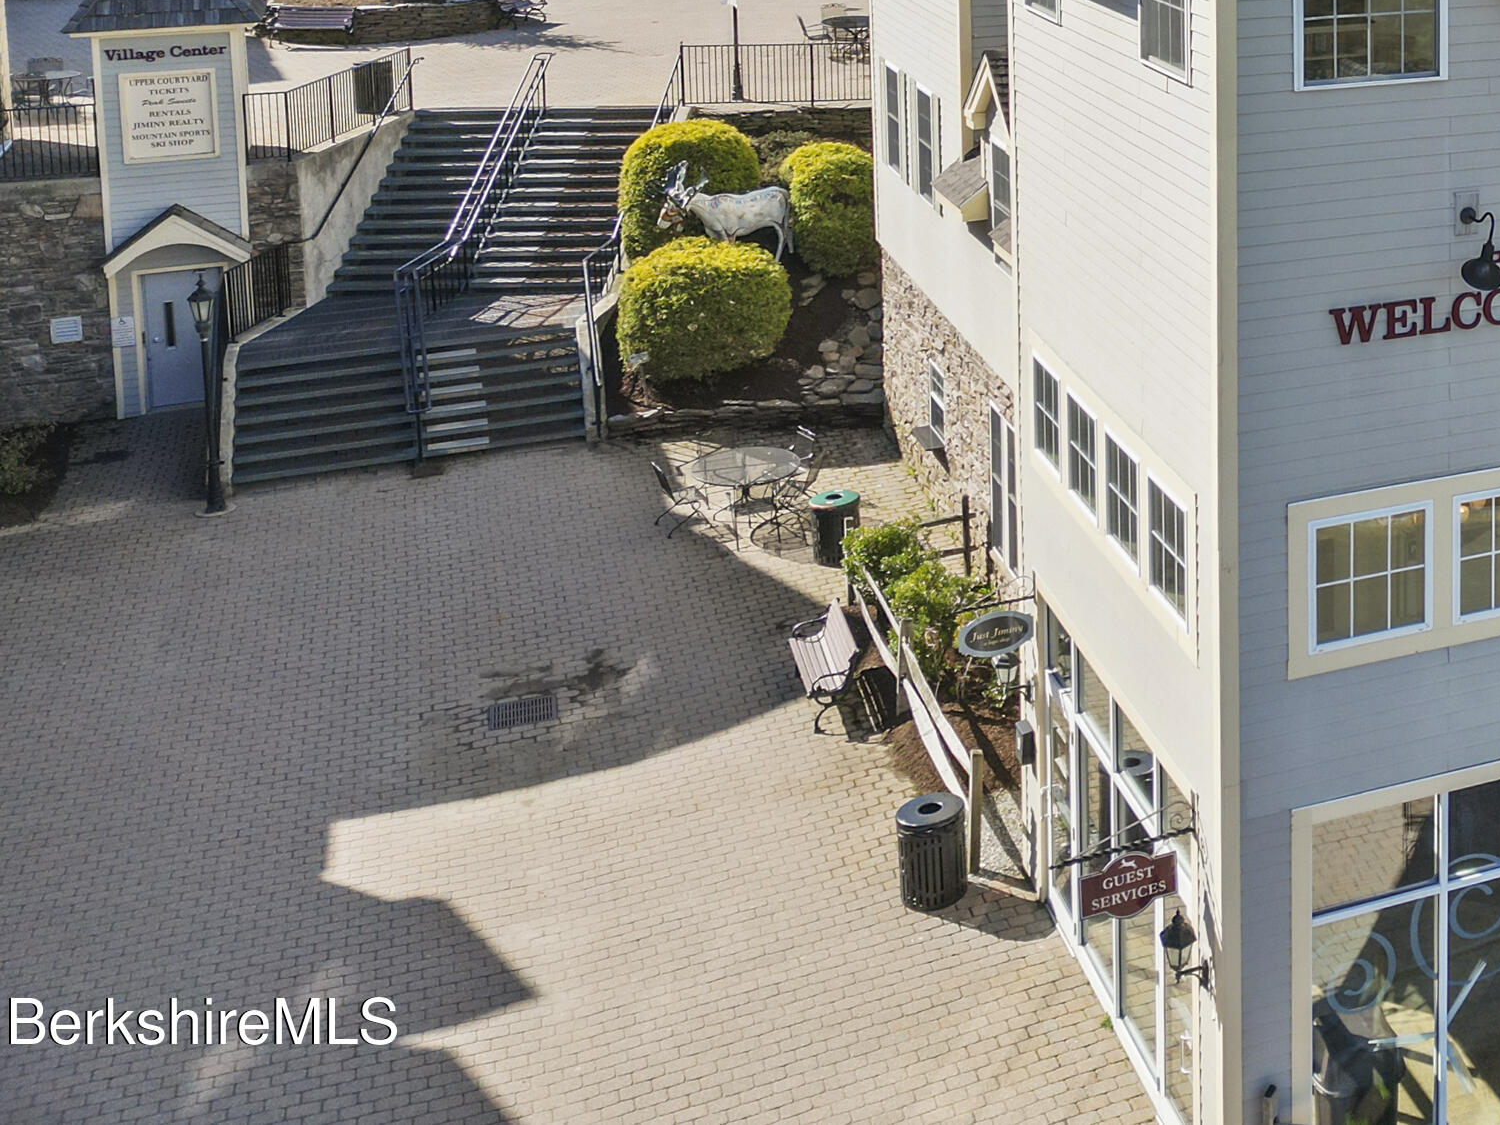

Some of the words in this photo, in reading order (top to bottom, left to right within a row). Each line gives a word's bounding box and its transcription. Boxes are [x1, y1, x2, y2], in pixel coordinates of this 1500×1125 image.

[104, 48, 165, 62] Village
[170, 45, 227, 58] Center
[129, 76, 155, 87] UPPER
[157, 74, 208, 85] COURTYARD
[148, 87, 190, 96] TICKETS
[149, 109, 192, 118] RENTALS
[132, 121, 167, 130] JIMINY
[168, 118, 205, 127] REALTY
[131, 131, 177, 141] MOUNTAIN
[179, 129, 211, 138] SPORTS
[150, 140, 166, 148] SKI
[168, 139, 195, 147] SHOP
[1102, 865, 1155, 890] GUEST
[1091, 880, 1167, 911] SERVICES
